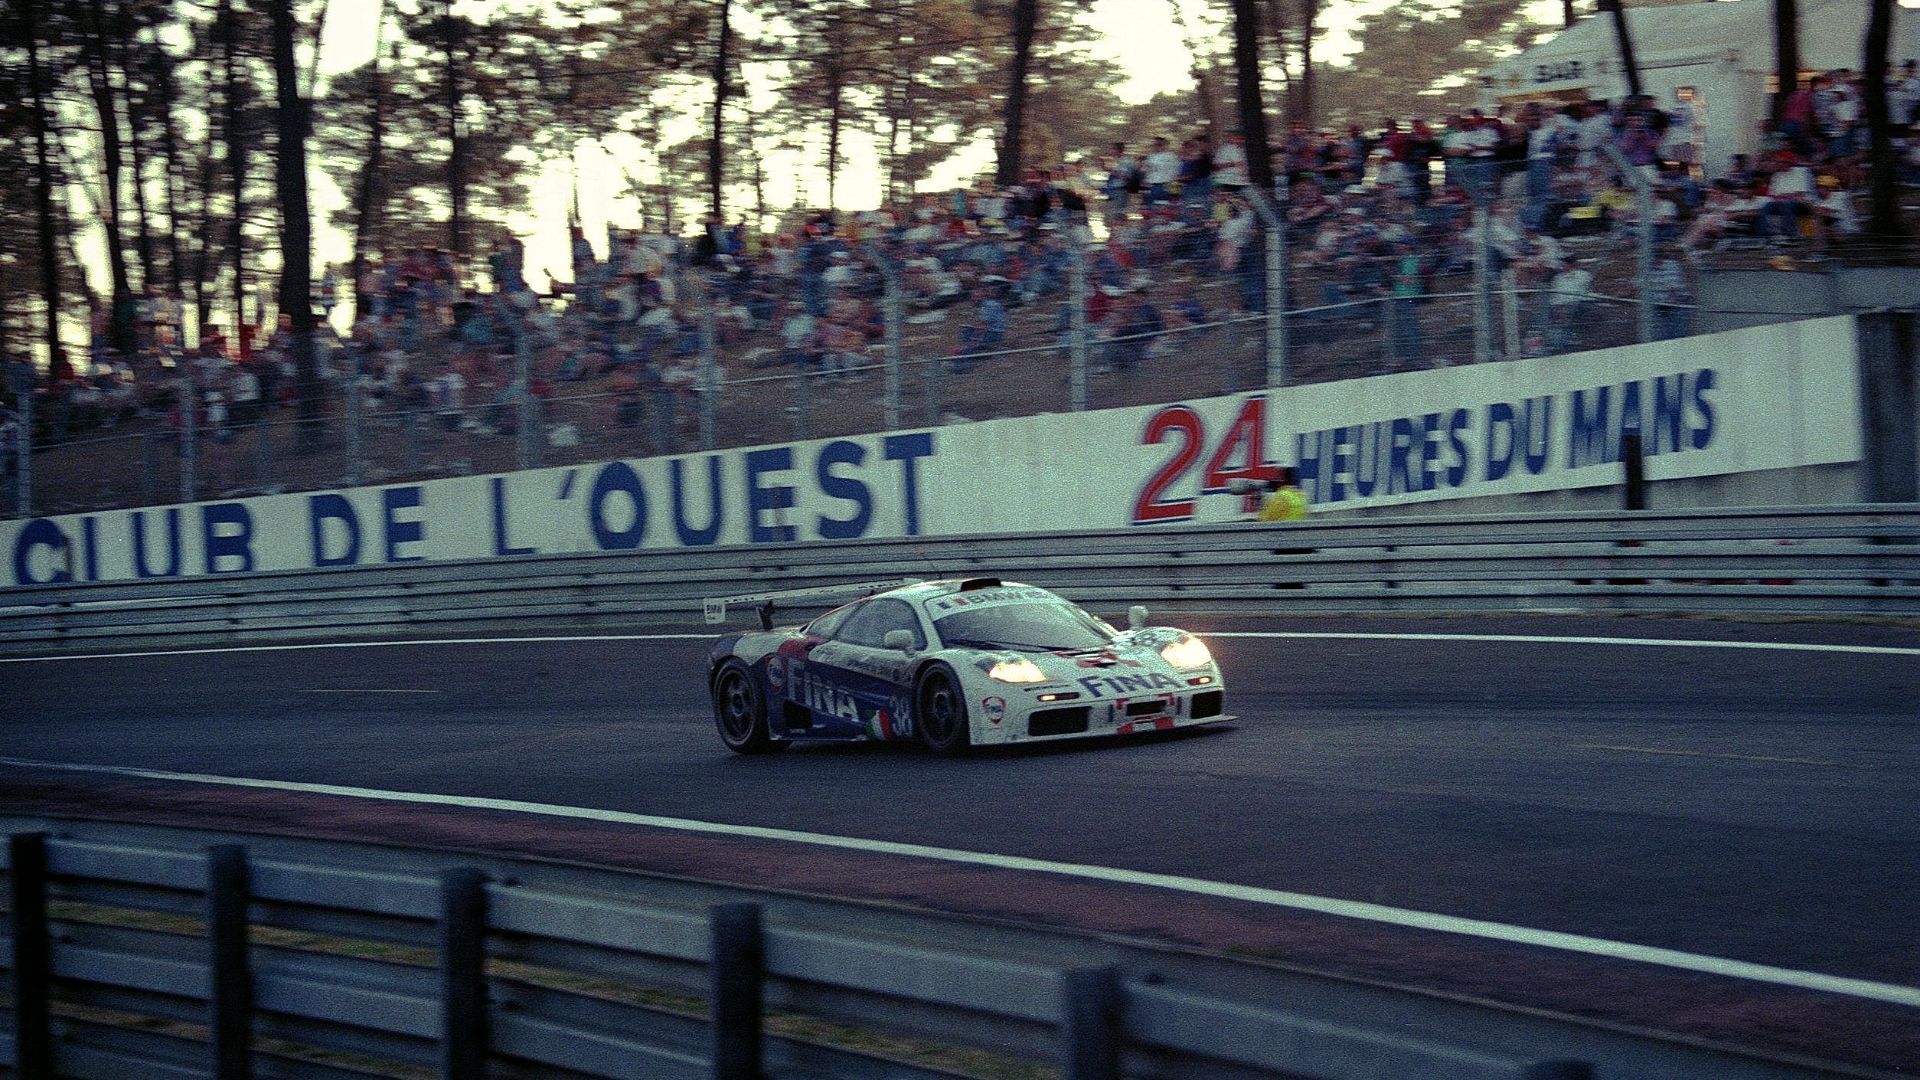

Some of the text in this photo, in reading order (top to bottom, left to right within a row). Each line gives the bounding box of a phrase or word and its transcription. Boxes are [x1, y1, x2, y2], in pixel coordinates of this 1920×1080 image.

[1132, 369, 1716, 525] 24 HEURES DU MANS
[308, 486, 425, 567] DE
[492, 432, 934, 556] L'OUEST
[967, 591, 1022, 604] BMW
[787, 656, 860, 723] FINA
[1077, 673, 1187, 699] FINA
[889, 695, 913, 737] 38
